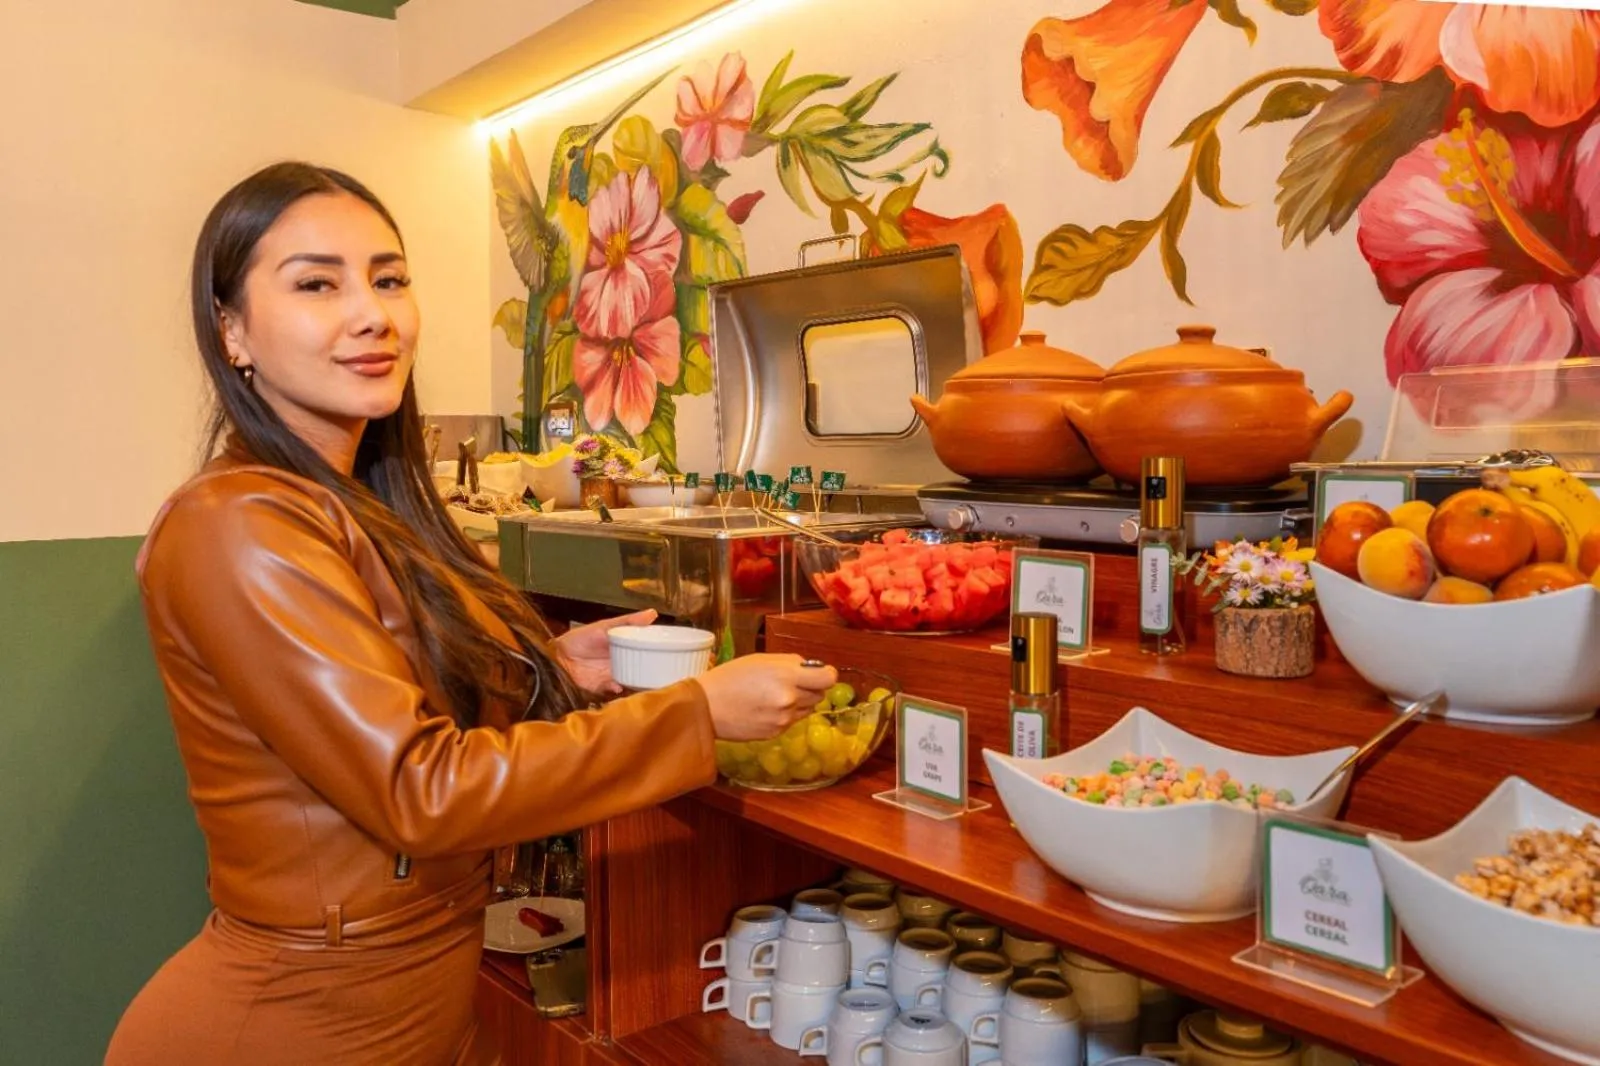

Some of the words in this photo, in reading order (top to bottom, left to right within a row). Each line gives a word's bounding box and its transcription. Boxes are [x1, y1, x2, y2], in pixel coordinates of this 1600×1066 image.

[1016, 735, 1024, 758] CEITE
[1028, 730, 1036, 758] OLIVA
[1305, 910, 1348, 932] CEREAL
[1305, 924, 1349, 946] CEREAL
